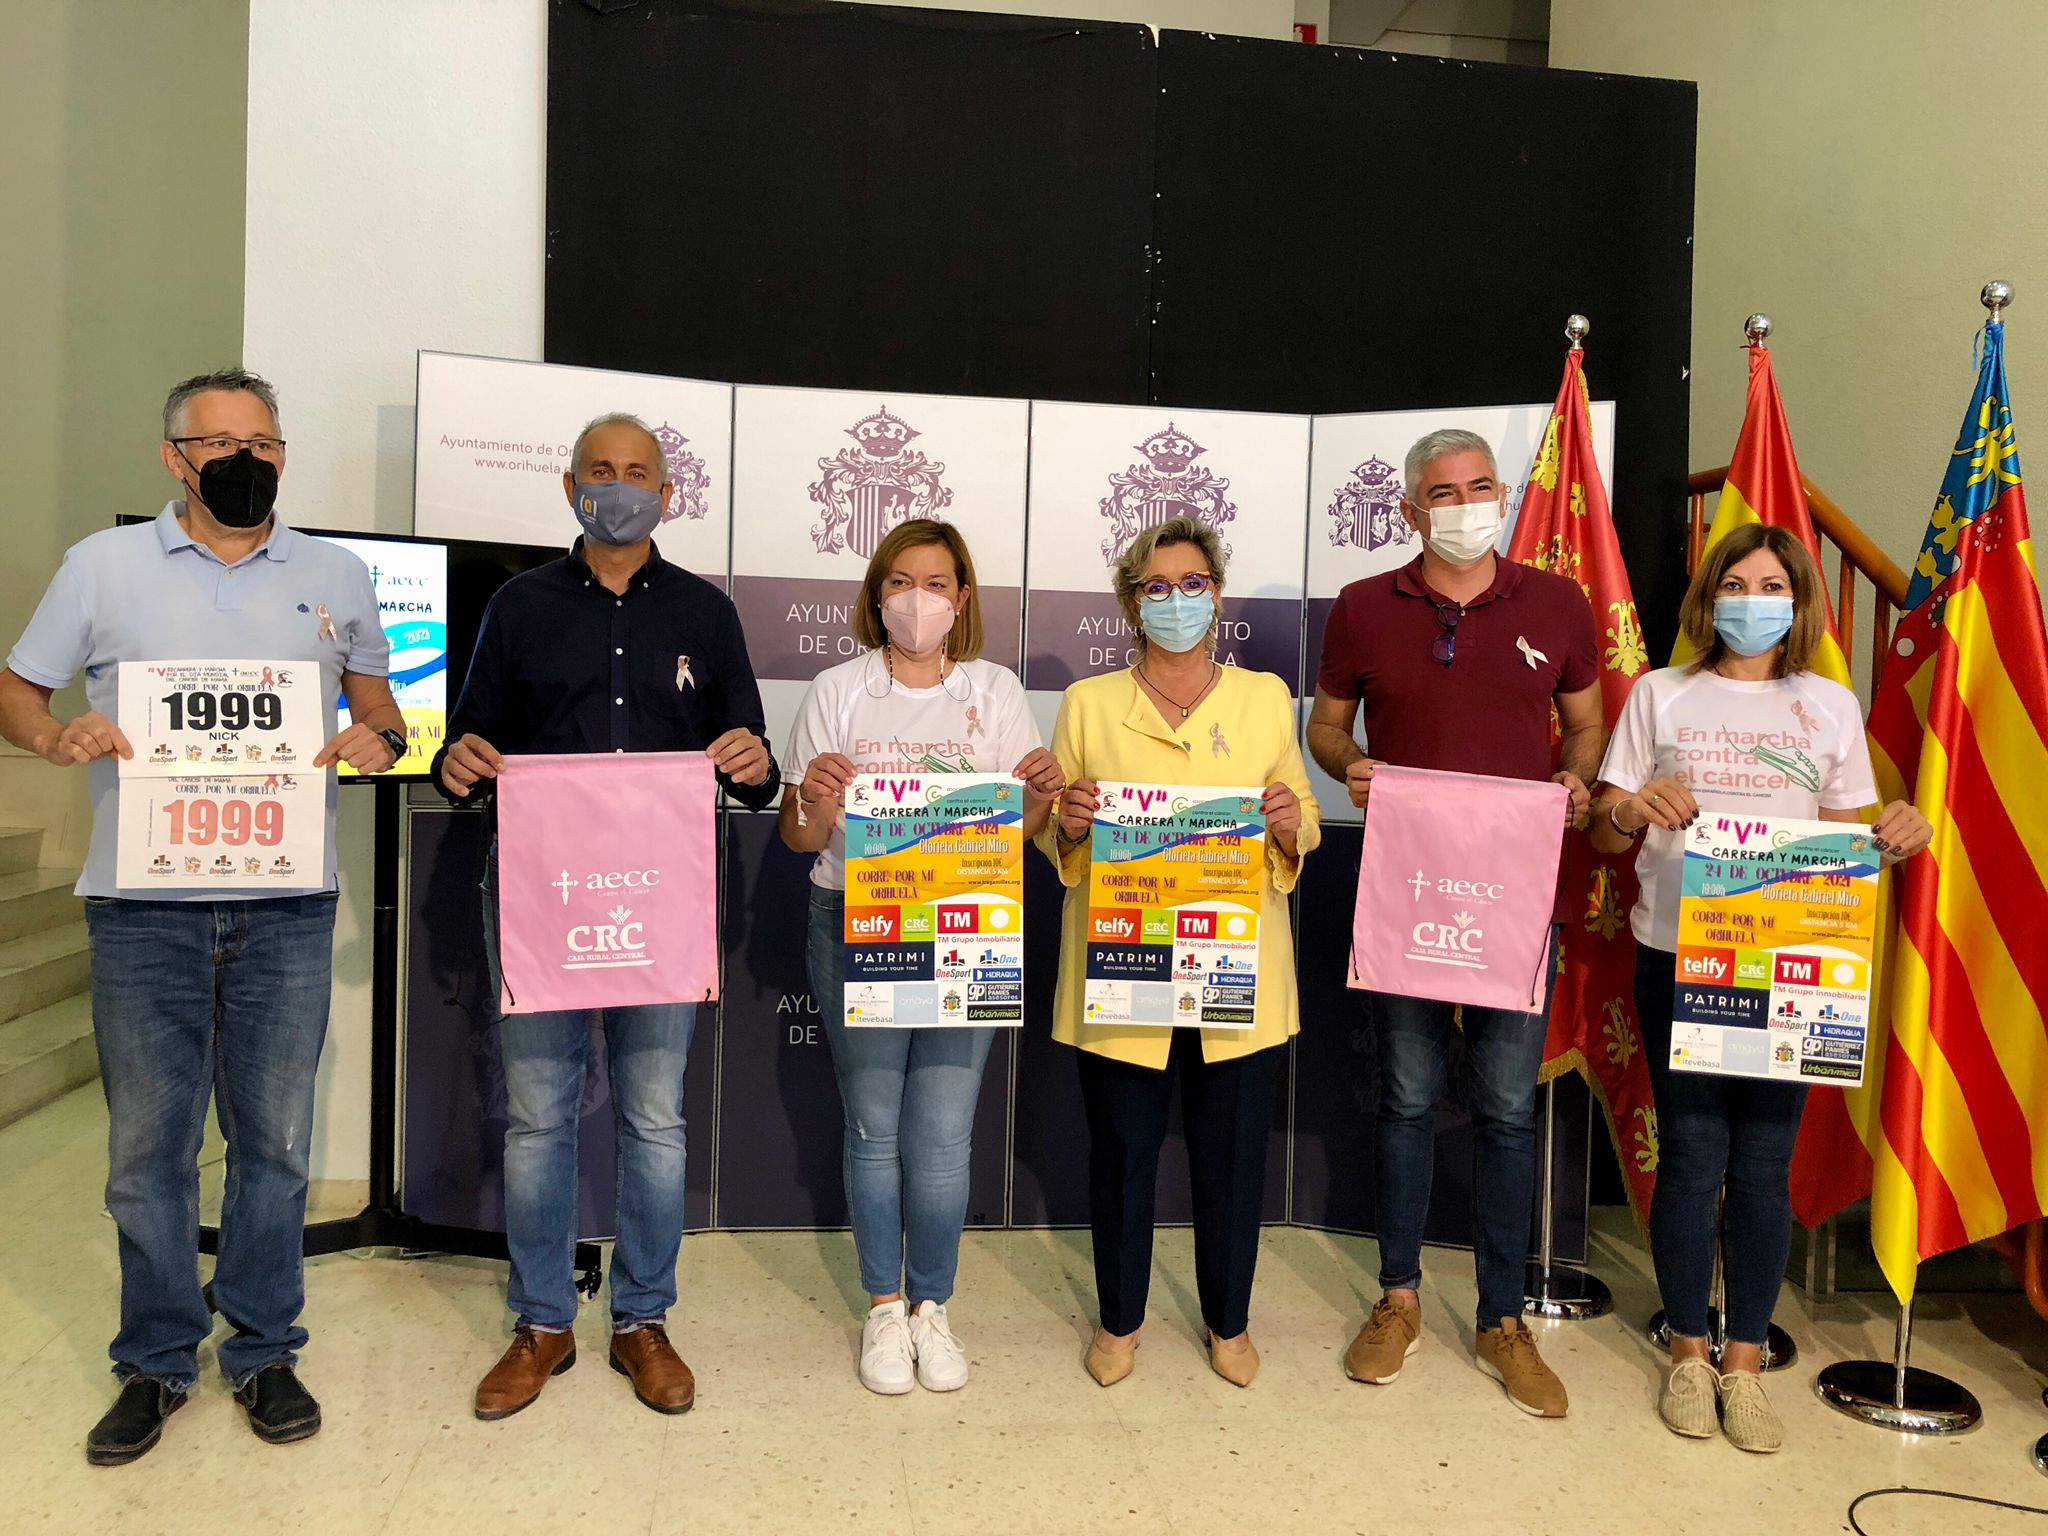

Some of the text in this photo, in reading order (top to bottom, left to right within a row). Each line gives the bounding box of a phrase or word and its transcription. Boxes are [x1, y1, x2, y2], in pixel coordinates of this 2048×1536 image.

[440, 434, 533, 454] Ayuntamiento
[537, 444, 552, 456] de
[379, 601, 432, 613] MARCHA
[800, 635, 828, 654] DE
[1090, 647, 1116, 666] DE
[162, 692, 282, 730] 1999
[209, 732, 239, 741] NICK
[1677, 727, 1812, 749] En marcha
[855, 739, 975, 756] En marcha
[211, 755, 238, 763] OneSport
[270, 755, 296, 763] OneSport
[1674, 748, 1759, 766] contra
[855, 758, 928, 774] contra
[1674, 766, 1796, 790] el cáncer
[176, 785, 201, 794] CORRE
[206, 785, 221, 794] POR
[871, 806, 994, 818] CARRERA Y MARCHA
[162, 799, 284, 846] 1999
[866, 822, 999, 837] 24 DE OCTUBRE 2021
[1118, 815, 1237, 829] CARRERA Y MARCHA
[919, 838, 953, 854] Glorieta
[955, 838, 986, 854] Gabriel
[1112, 830, 1241, 847] 24 DE OCTUBRE 2021
[1163, 848, 1196, 862] Glorieta
[1198, 849, 1228, 864] Gabriel
[1712, 847, 1846, 868] CARRERA Y MARCHA
[586, 870, 659, 890] aecc
[857, 870, 889, 883] CORRE
[895, 870, 915, 882] POR
[1102, 875, 1132, 888] CORRE
[1139, 875, 1158, 888] POR
[1705, 863, 1851, 887] 24 DE OCTUBRE 2021
[871, 886, 918, 900] ORIHUELA
[1437, 878, 1504, 899] aecc
[1760, 884, 1797, 901] Glorieta
[1800, 887, 1835, 904] Gabriel
[1114, 891, 1160, 904] ORIHUELA
[851, 915, 893, 936] telfy
[904, 918, 929, 928] CRC
[942, 912, 971, 928] TM
[1182, 918, 1209, 933] TM
[1692, 910, 1726, 926] CORRE
[1732, 912, 1754, 928] POR
[1094, 917, 1134, 938] telfy
[1145, 922, 1168, 932] CRC
[567, 922, 646, 952] CRC
[951, 936, 974, 945] Grupo
[1413, 922, 1483, 953] CRC
[1706, 929, 1756, 944] ORIHUELA
[1189, 941, 1211, 949] Grupo
[1213, 942, 1256, 950] Inmobiliario
[855, 952, 925, 963] PATRIMI
[999, 955, 1017, 964] One
[1096, 952, 1163, 964] PATRIMI
[1234, 961, 1252, 970] One
[1683, 956, 1727, 978] telfy
[1738, 963, 1765, 975] CRC
[1780, 961, 1812, 980] TM
[936, 968, 971, 980] OneSport
[1172, 971, 1208, 983] OneSport
[1220, 976, 1253, 984] HIDRAQUA
[969, 984, 985, 1000] gp
[1203, 988, 1219, 1002] gp
[1773, 985, 1866, 1001] TM Grupo Inmobiliario
[1684, 993, 1759, 1009] PATRIMI
[1769, 1018, 1808, 1031] OneSport
[1841, 1012, 1861, 1022] One
[789, 1025, 818, 1044] DE
[1824, 1027, 1861, 1037] HIDRAQUA
[1803, 1037, 1822, 1055] gp
[1682, 1059, 1720, 1069] itevebasa
